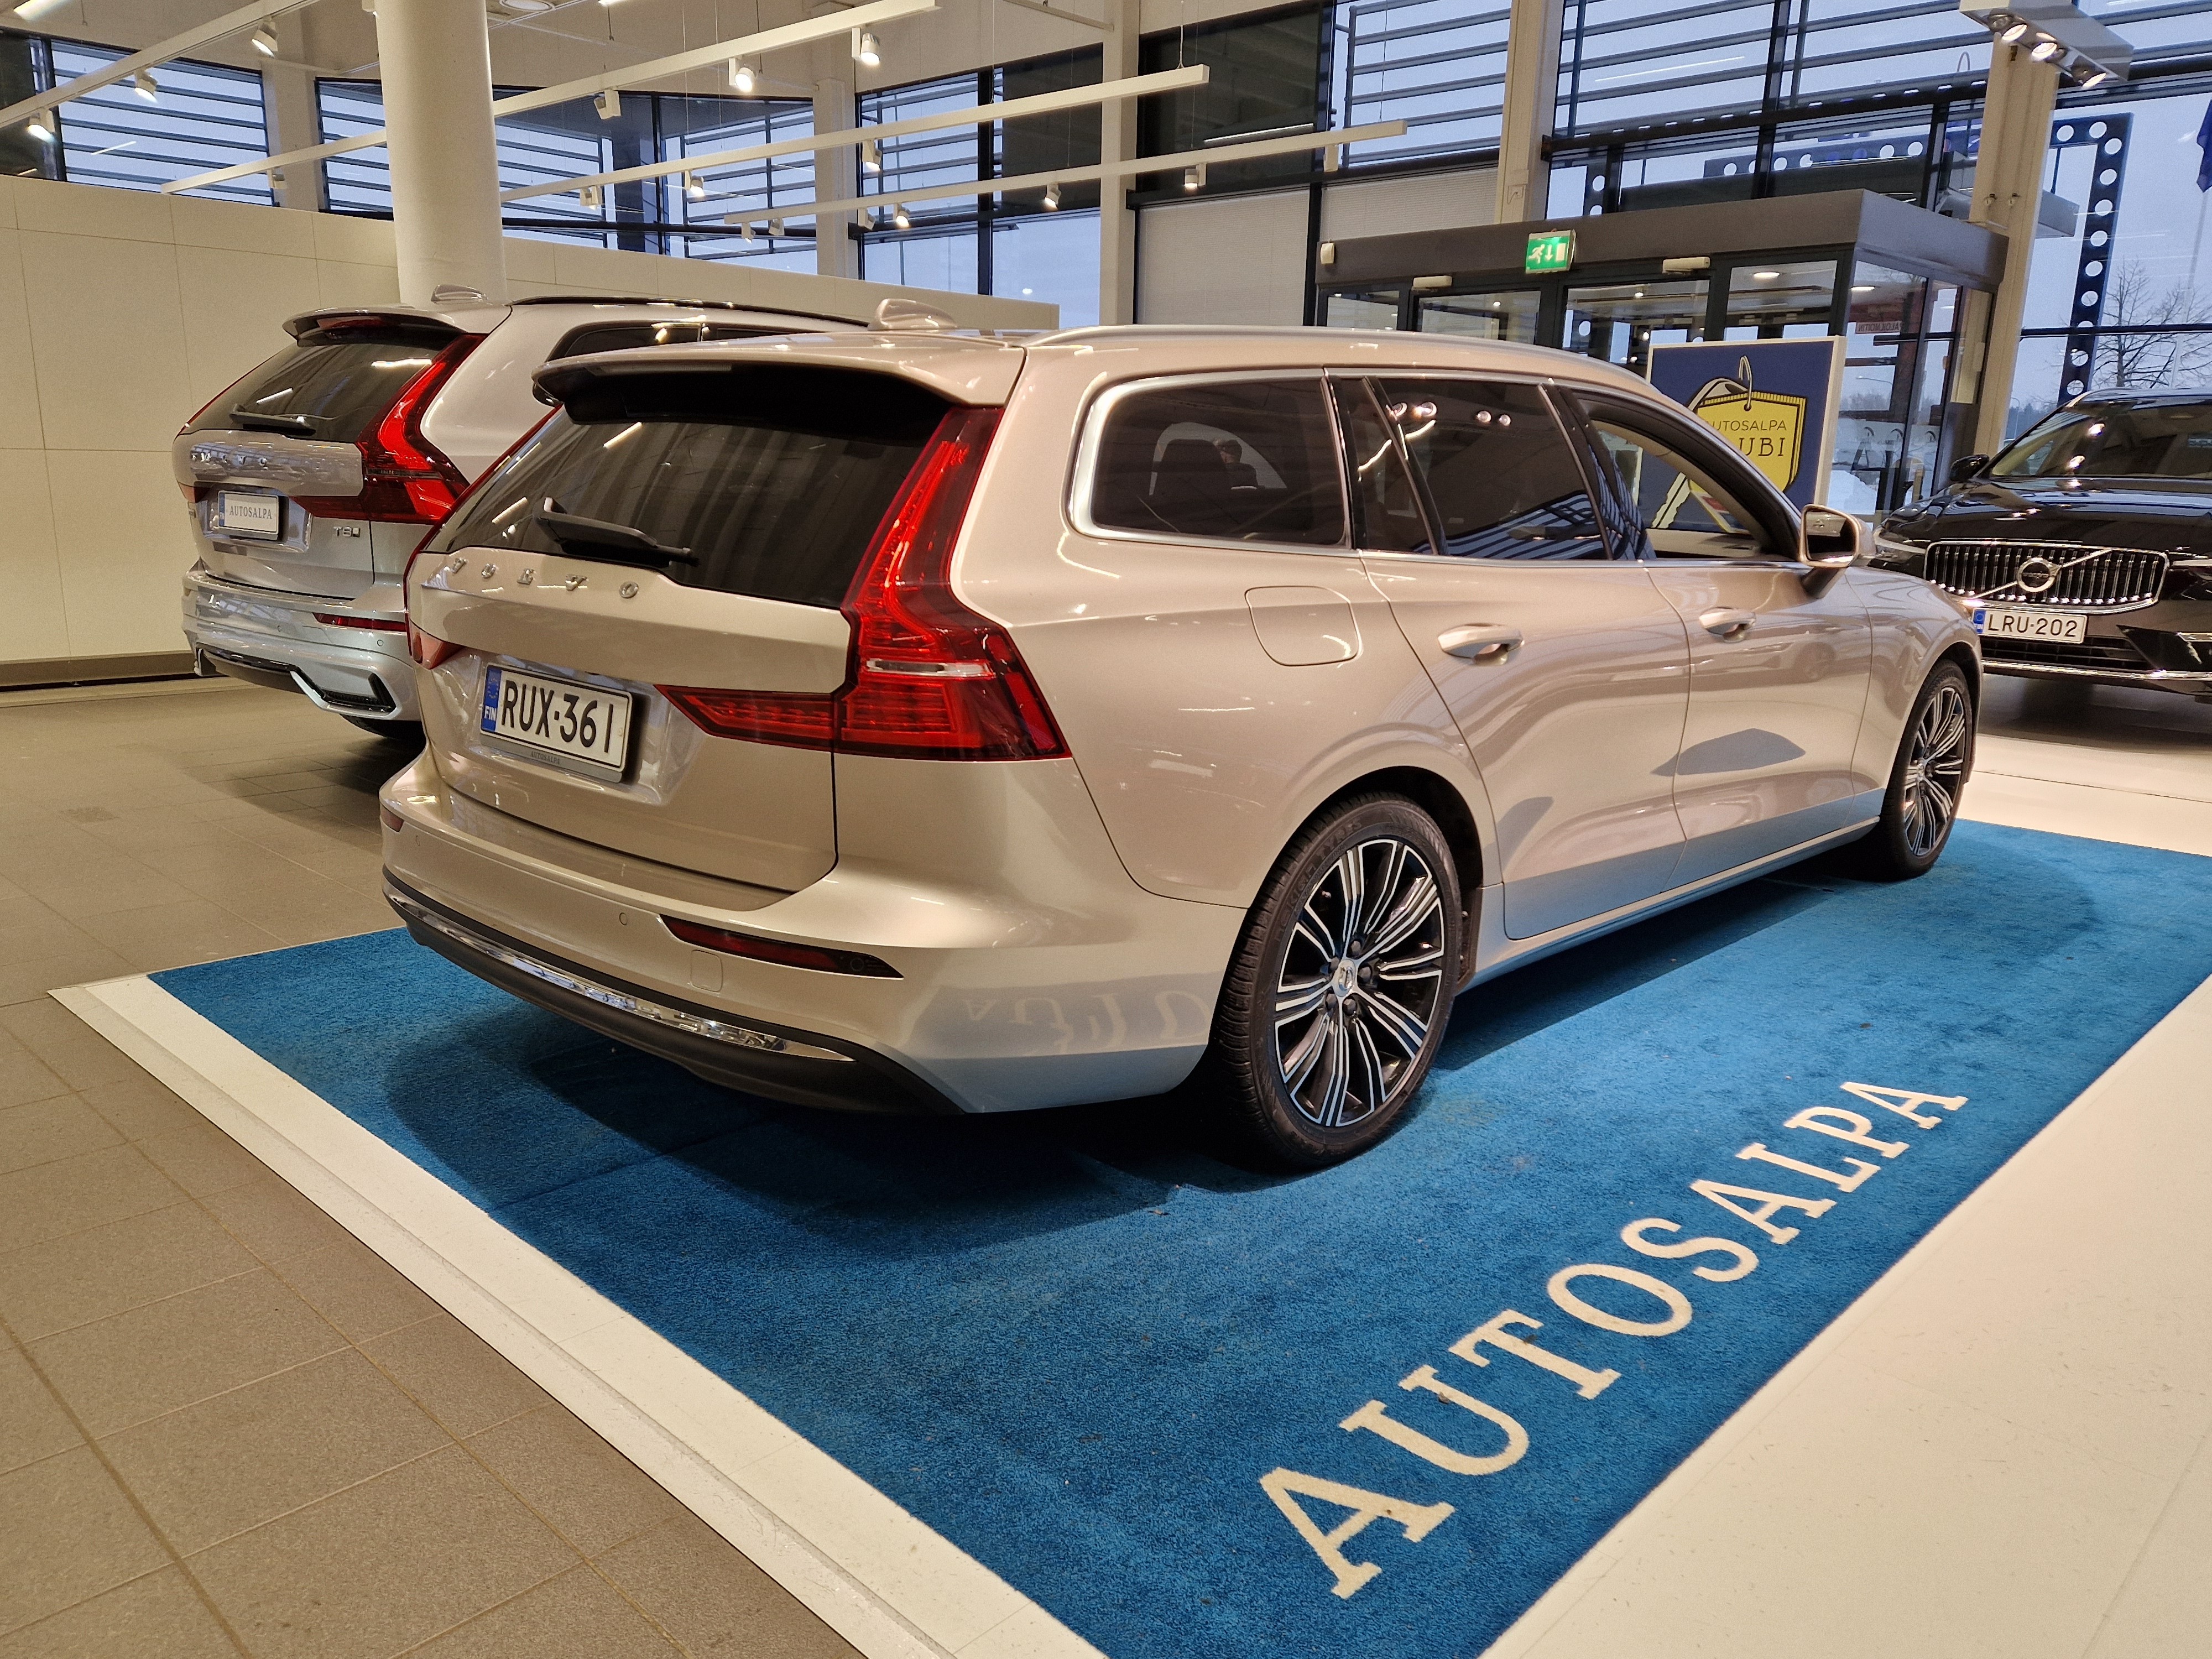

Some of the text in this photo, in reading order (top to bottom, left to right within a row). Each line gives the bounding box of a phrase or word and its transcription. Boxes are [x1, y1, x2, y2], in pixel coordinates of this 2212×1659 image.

[1706, 420, 1787, 431] UTOSALPA
[229, 505, 273, 520] AUTOSALPA
[451, 557, 639, 599] VOLVO
[1987, 613, 2078, 638] LRU-202
[484, 680, 614, 753] FIN RUX-361
[530, 750, 560, 765] AUTOSALPA
[1259, 1081, 1969, 1599] AUTOSALPA
